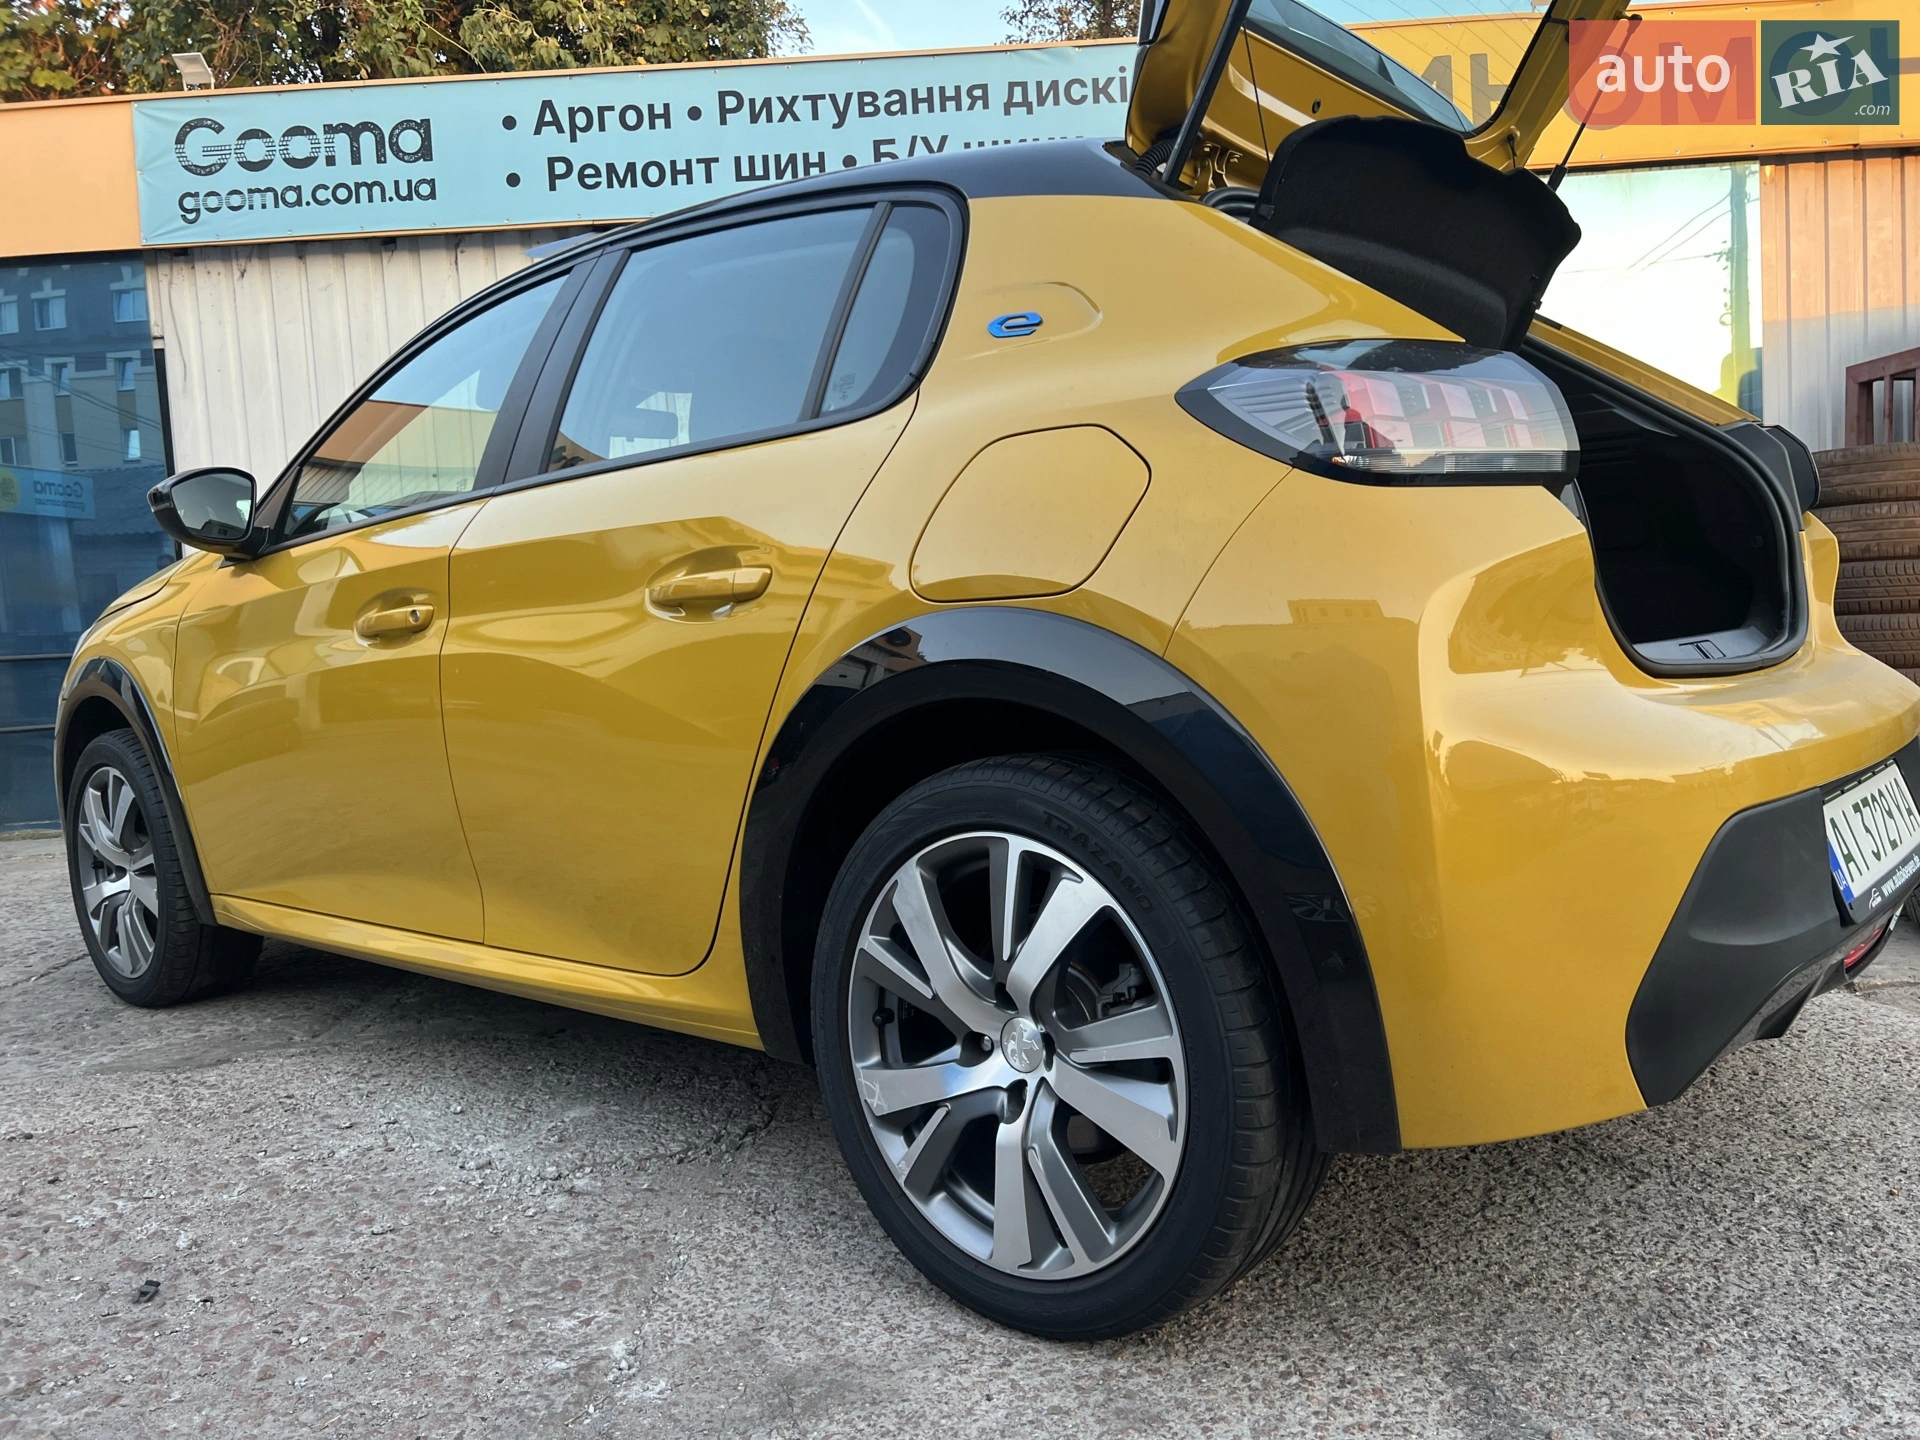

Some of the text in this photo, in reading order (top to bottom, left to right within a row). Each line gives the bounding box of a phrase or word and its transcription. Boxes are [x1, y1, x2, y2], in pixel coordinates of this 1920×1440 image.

[533, 65, 1129, 143] Аргон Рихтування дискі
[174, 117, 434, 177] Gooma
[545, 155, 720, 193] Ремонт
[733, 151, 826, 182] шин
[177, 175, 438, 224] gooma.com.ua
[1042, 809, 1156, 915] TRAZANO
